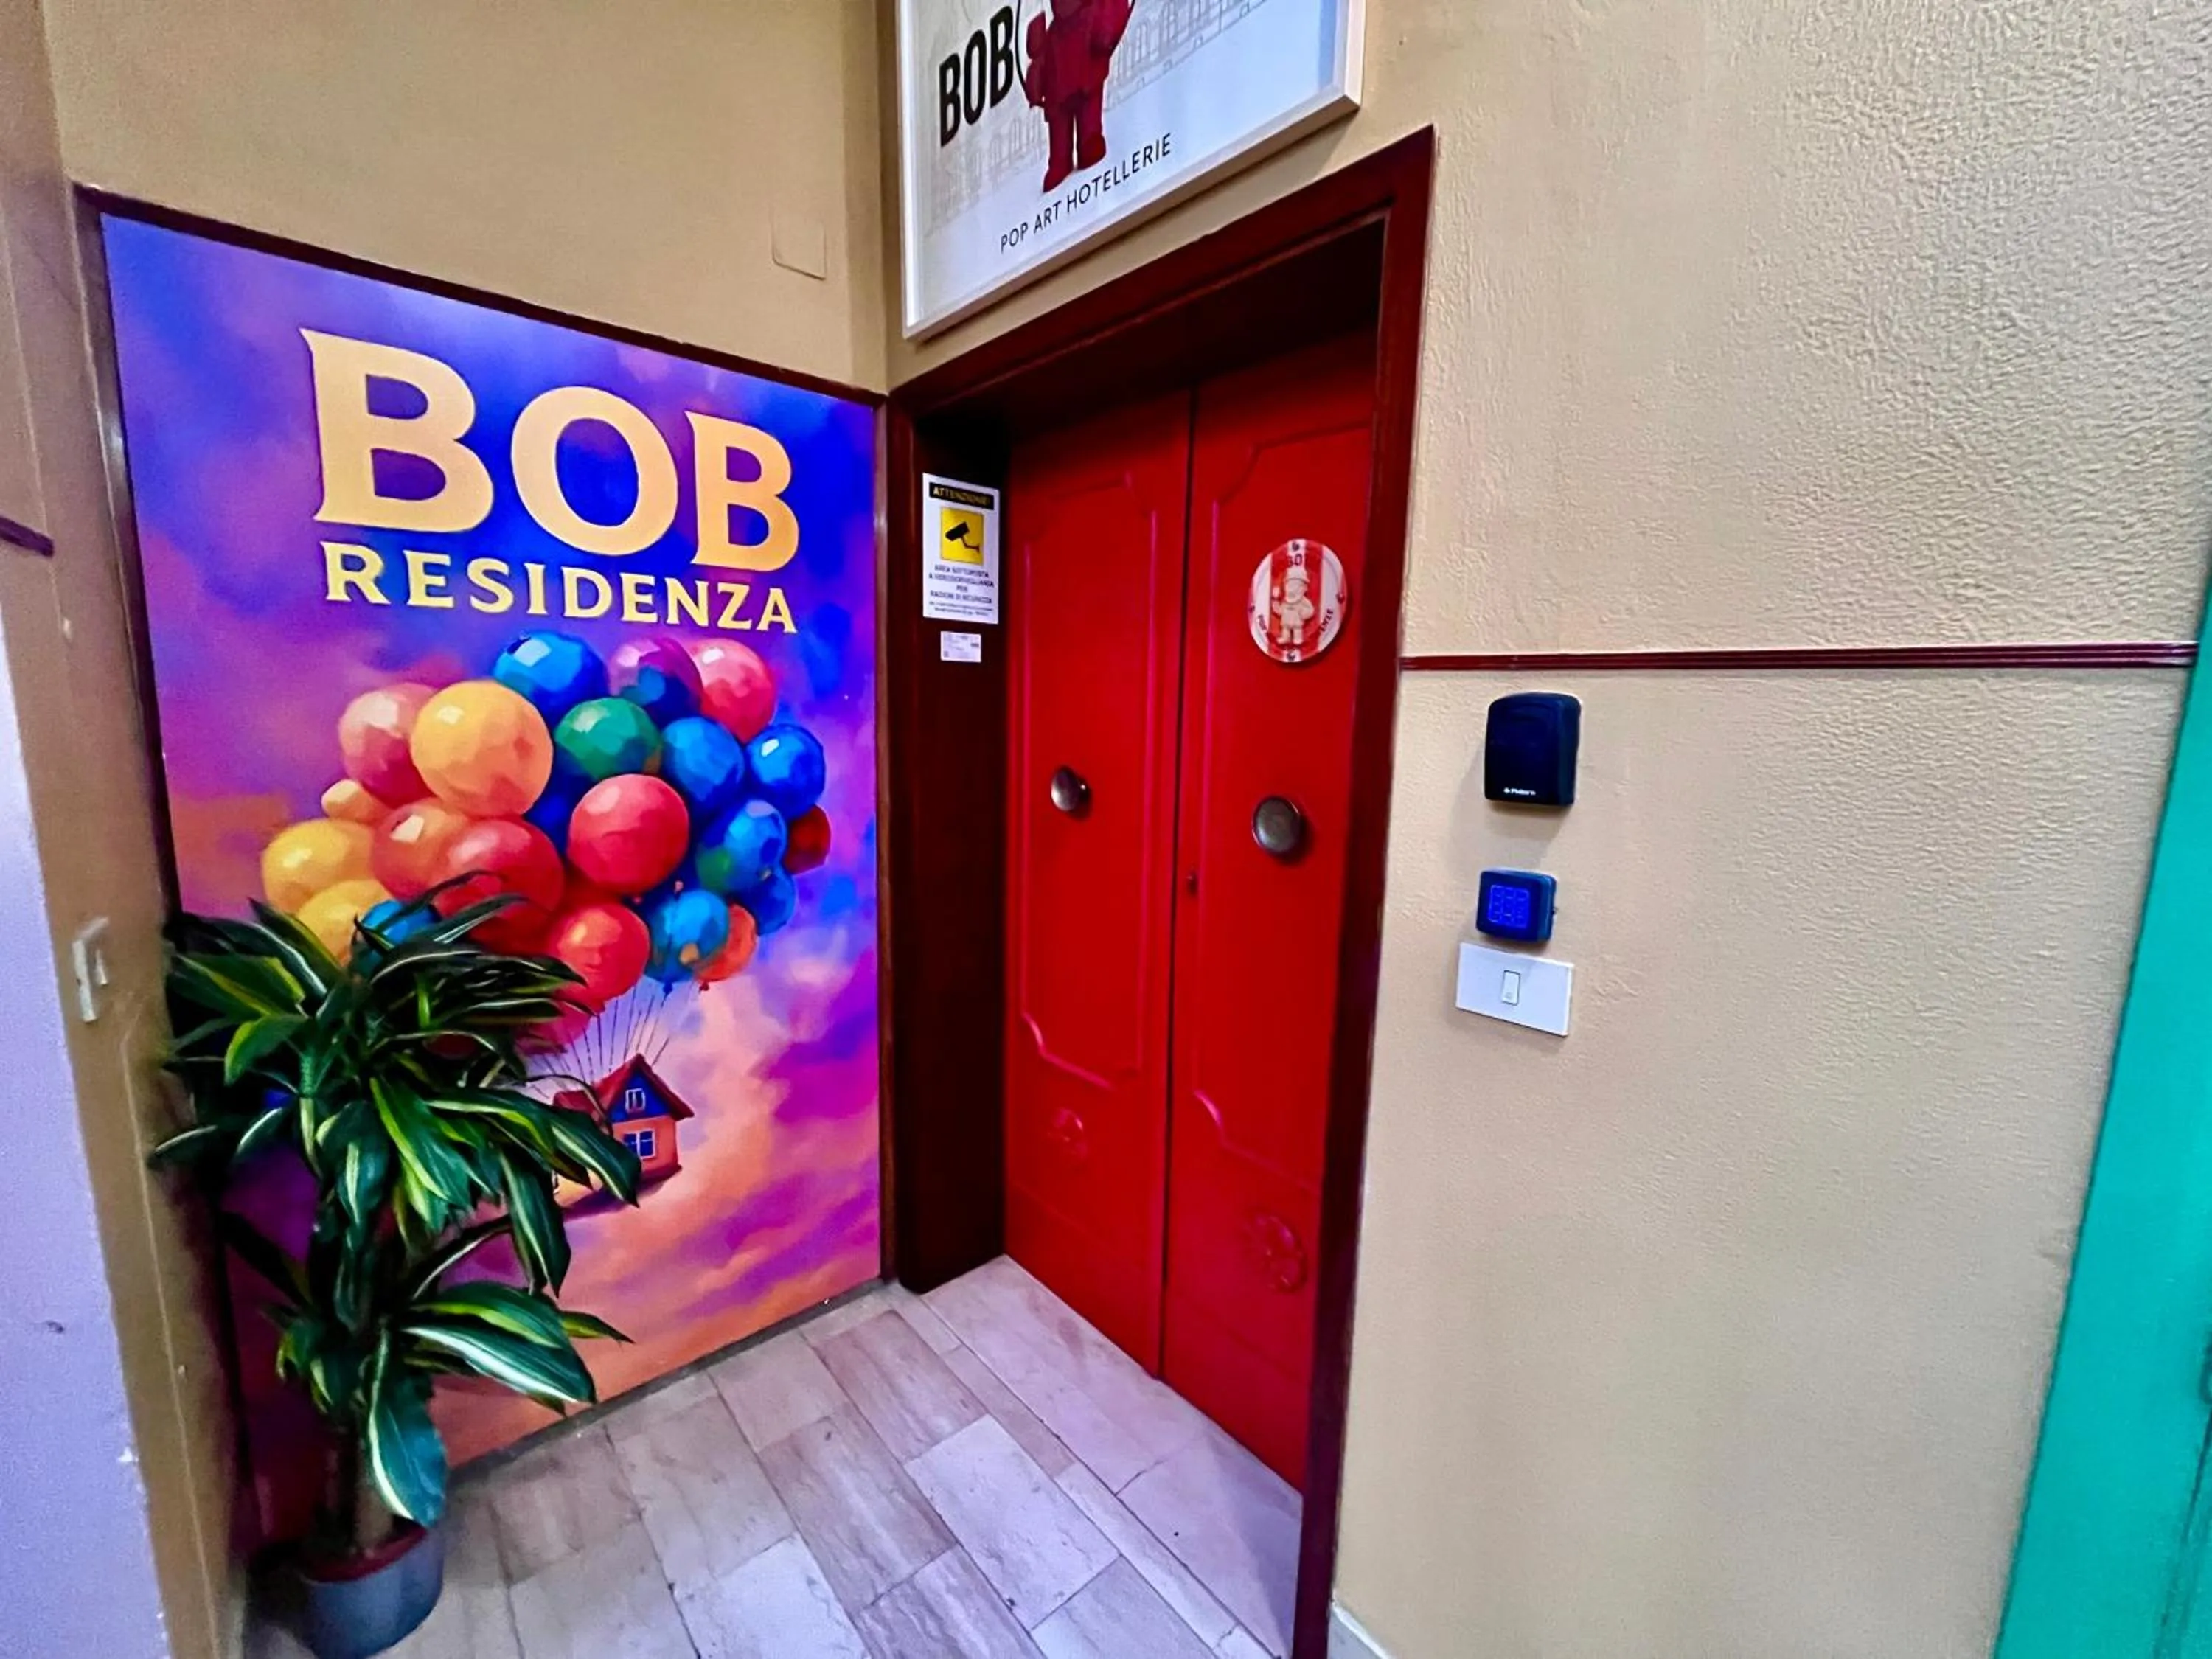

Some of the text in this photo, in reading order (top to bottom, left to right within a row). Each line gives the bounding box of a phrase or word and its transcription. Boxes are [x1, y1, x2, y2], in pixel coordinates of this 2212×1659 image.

[939, 5, 1014, 147] BOB
[1001, 133, 1171, 253] POP ART HOTELLERIE
[299, 327, 799, 572] BOB
[319, 540, 797, 634] RESIDENZA
